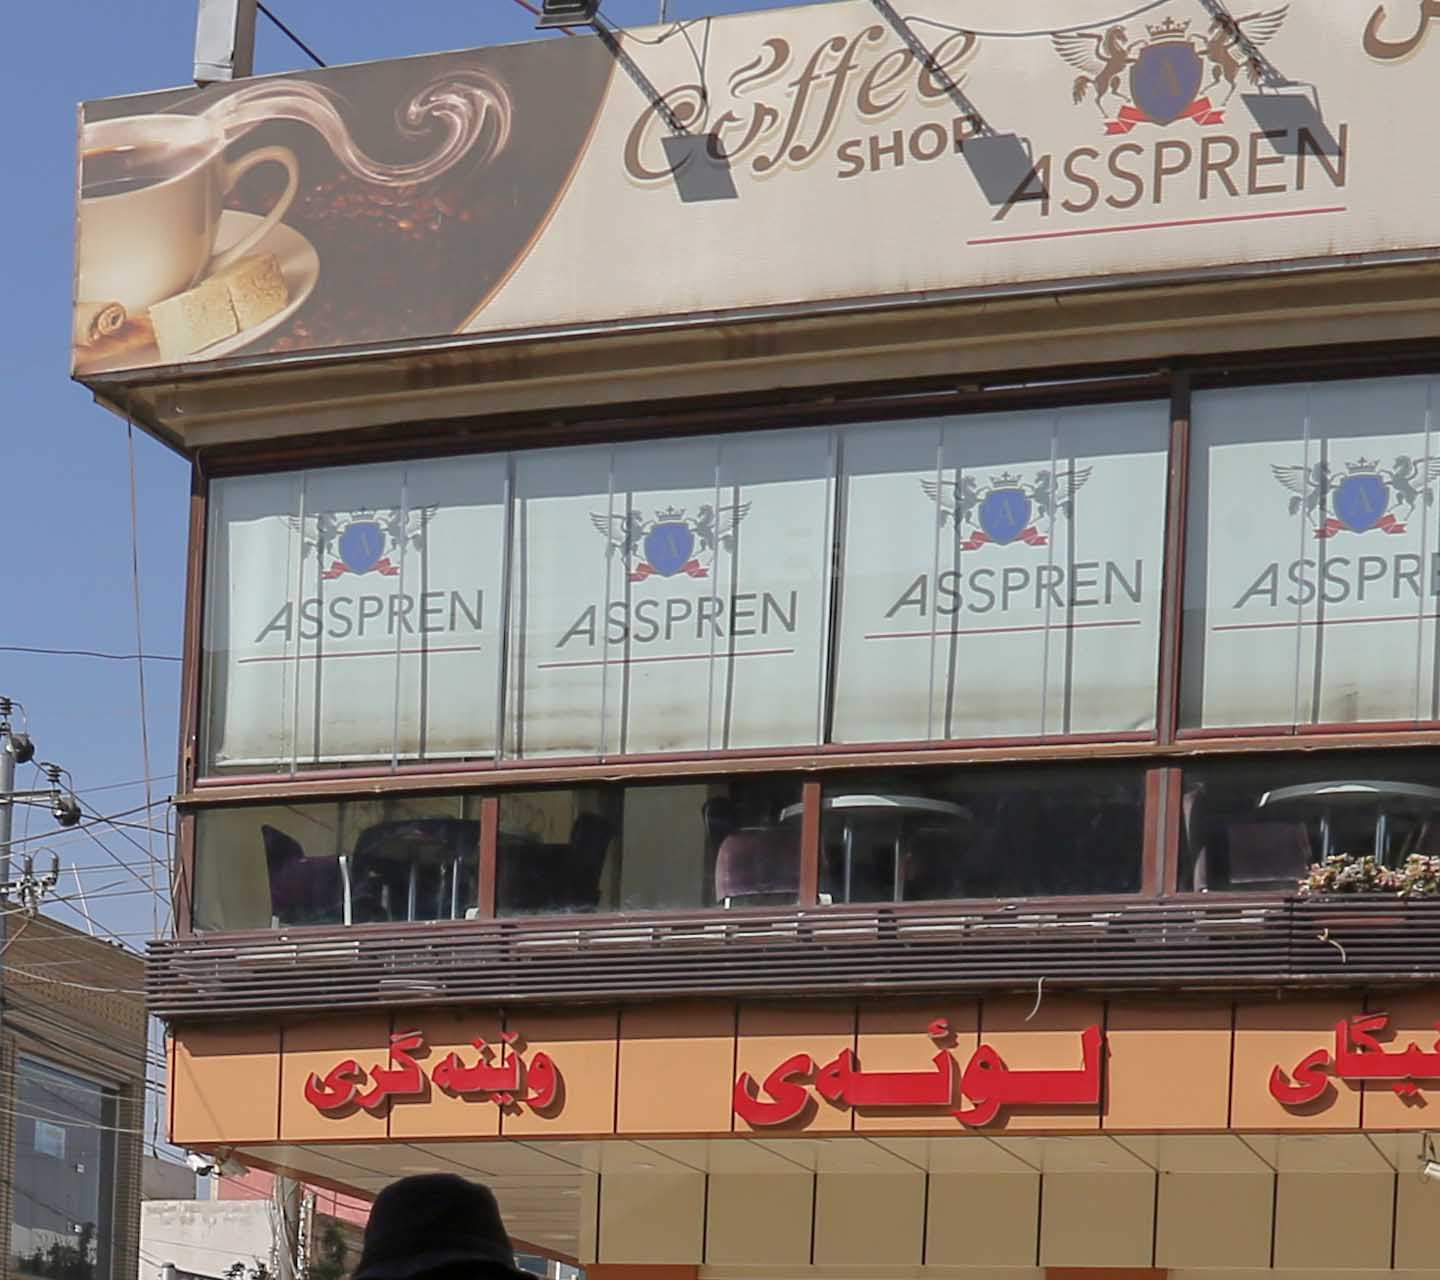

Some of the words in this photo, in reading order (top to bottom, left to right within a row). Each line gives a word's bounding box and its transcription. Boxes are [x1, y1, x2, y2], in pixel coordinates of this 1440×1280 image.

[625, 27, 978, 182] Coffee
[836, 113, 983, 179] SHOP
[992, 123, 1349, 222] ASSPREN
[256, 590, 484, 644] ASSPREN
[887, 559, 1144, 618] ASSPREN
[556, 591, 800, 651] ASSPREN
